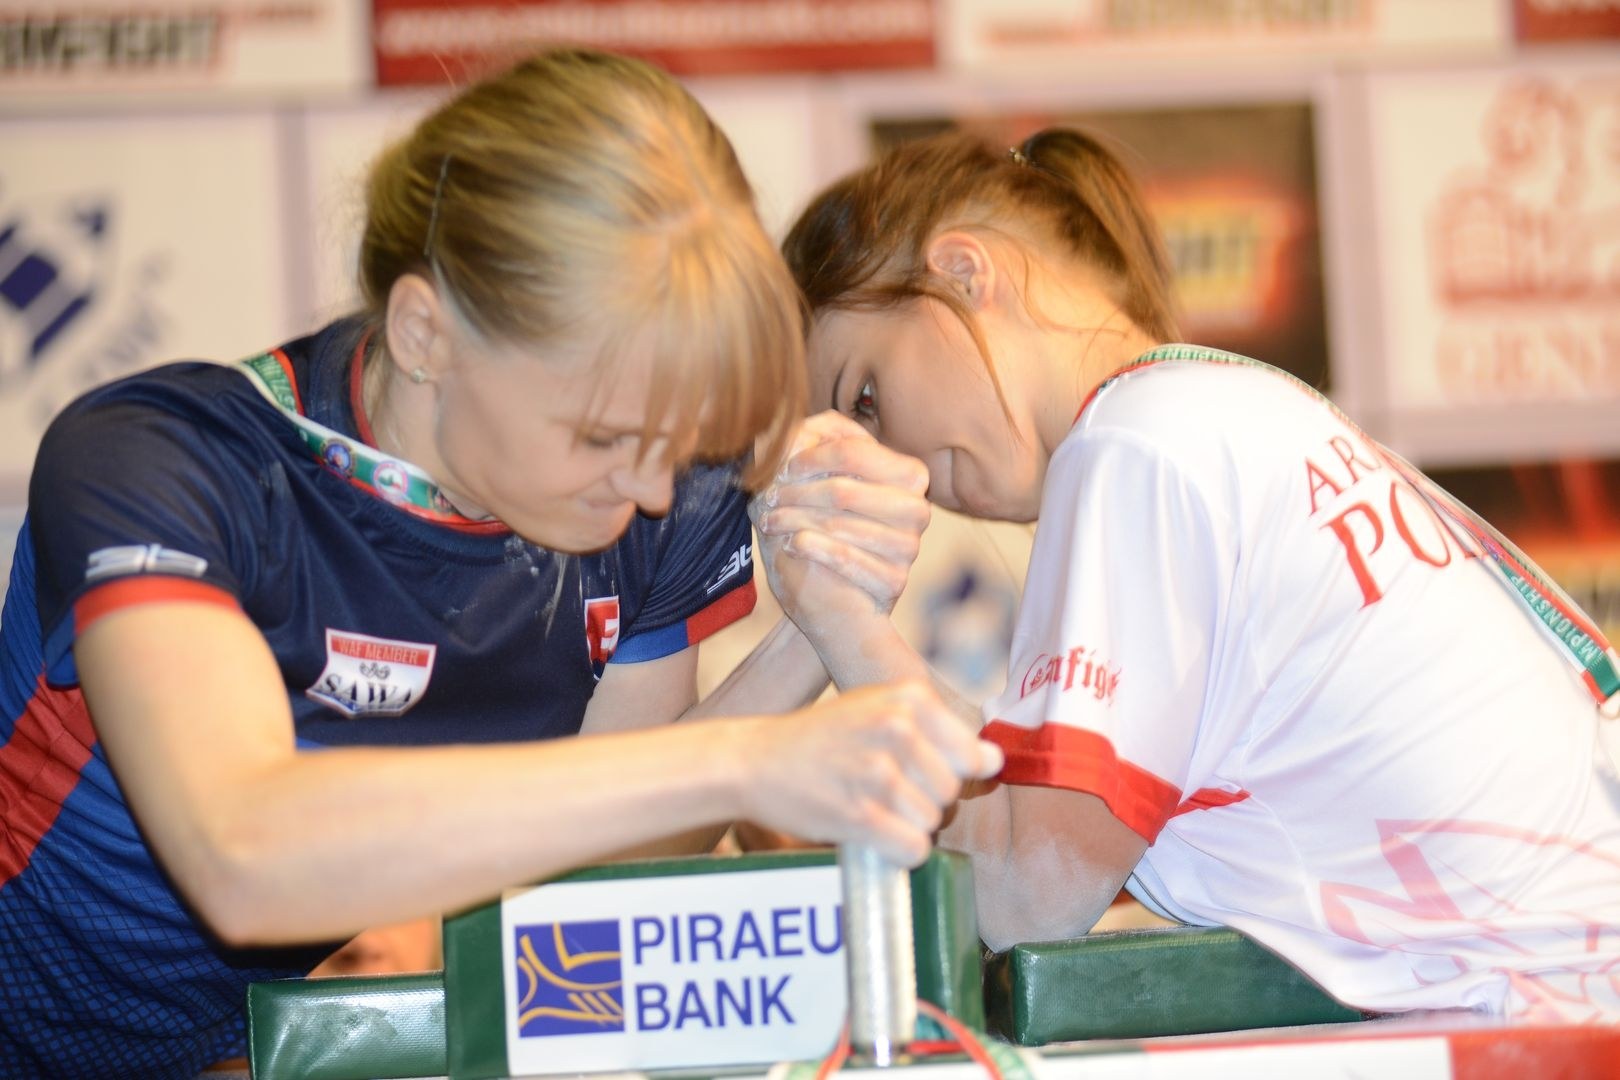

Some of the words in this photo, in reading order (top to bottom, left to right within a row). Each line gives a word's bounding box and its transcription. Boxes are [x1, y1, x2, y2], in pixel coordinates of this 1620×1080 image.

[1304, 436, 1382, 517] AR
[1318, 479, 1478, 611] PO
[365, 641, 420, 665] MEMBER
[1510, 574, 1603, 664] MPIONSHIP
[633, 904, 846, 965] PIRAEU
[635, 974, 796, 1032] BANK
